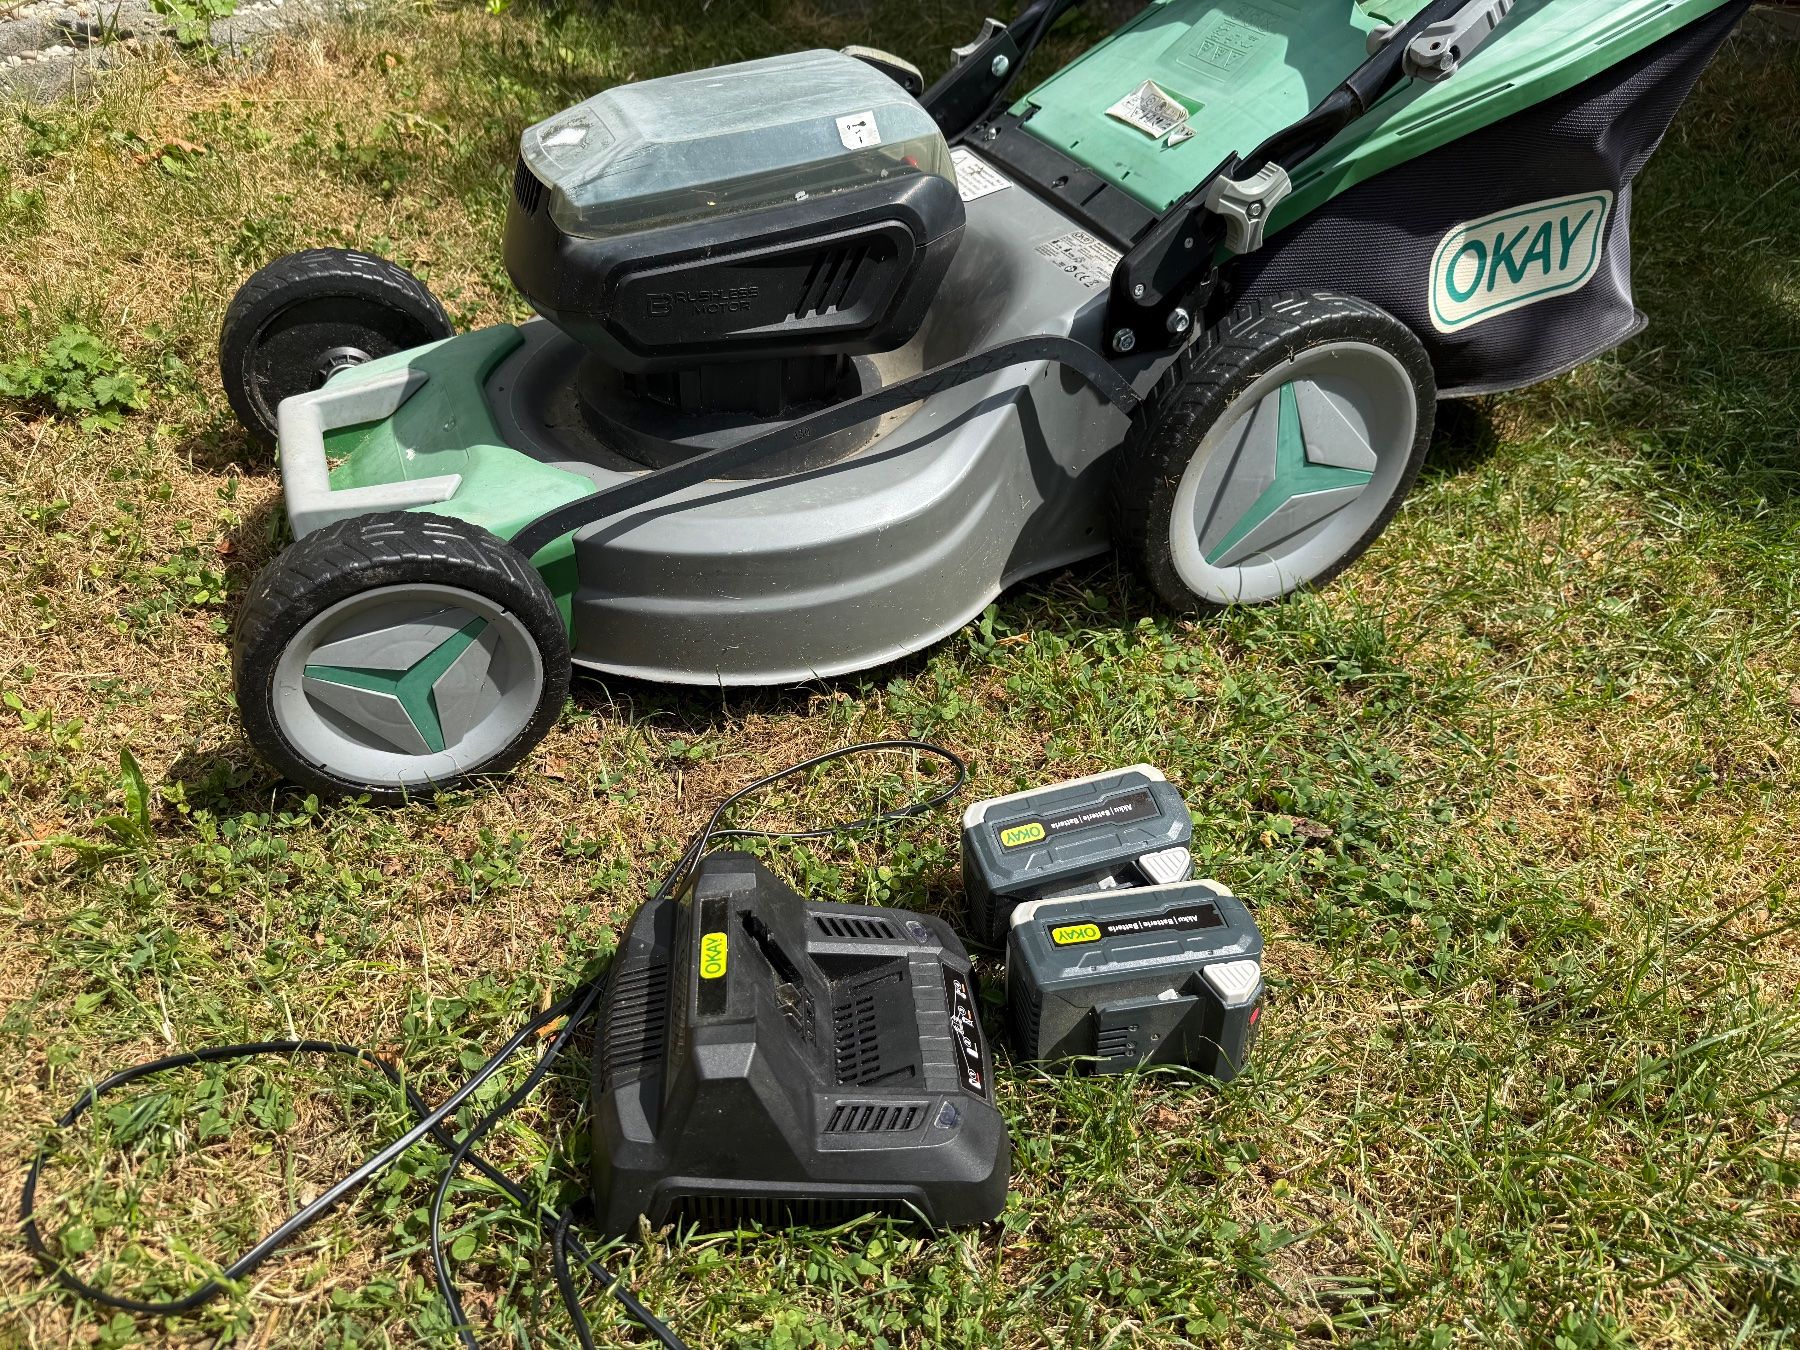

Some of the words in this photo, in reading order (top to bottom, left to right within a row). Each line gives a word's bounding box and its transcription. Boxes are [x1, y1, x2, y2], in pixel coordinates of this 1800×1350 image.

[1445, 208, 1594, 303] OKAY
[694, 301, 751, 315] MOTOR
[1114, 803, 1132, 814] Akku
[1005, 826, 1041, 845] OKAY
[1178, 914, 1198, 923] Akku
[1058, 927, 1097, 941] OKAY
[704, 937, 722, 974] OKAY
